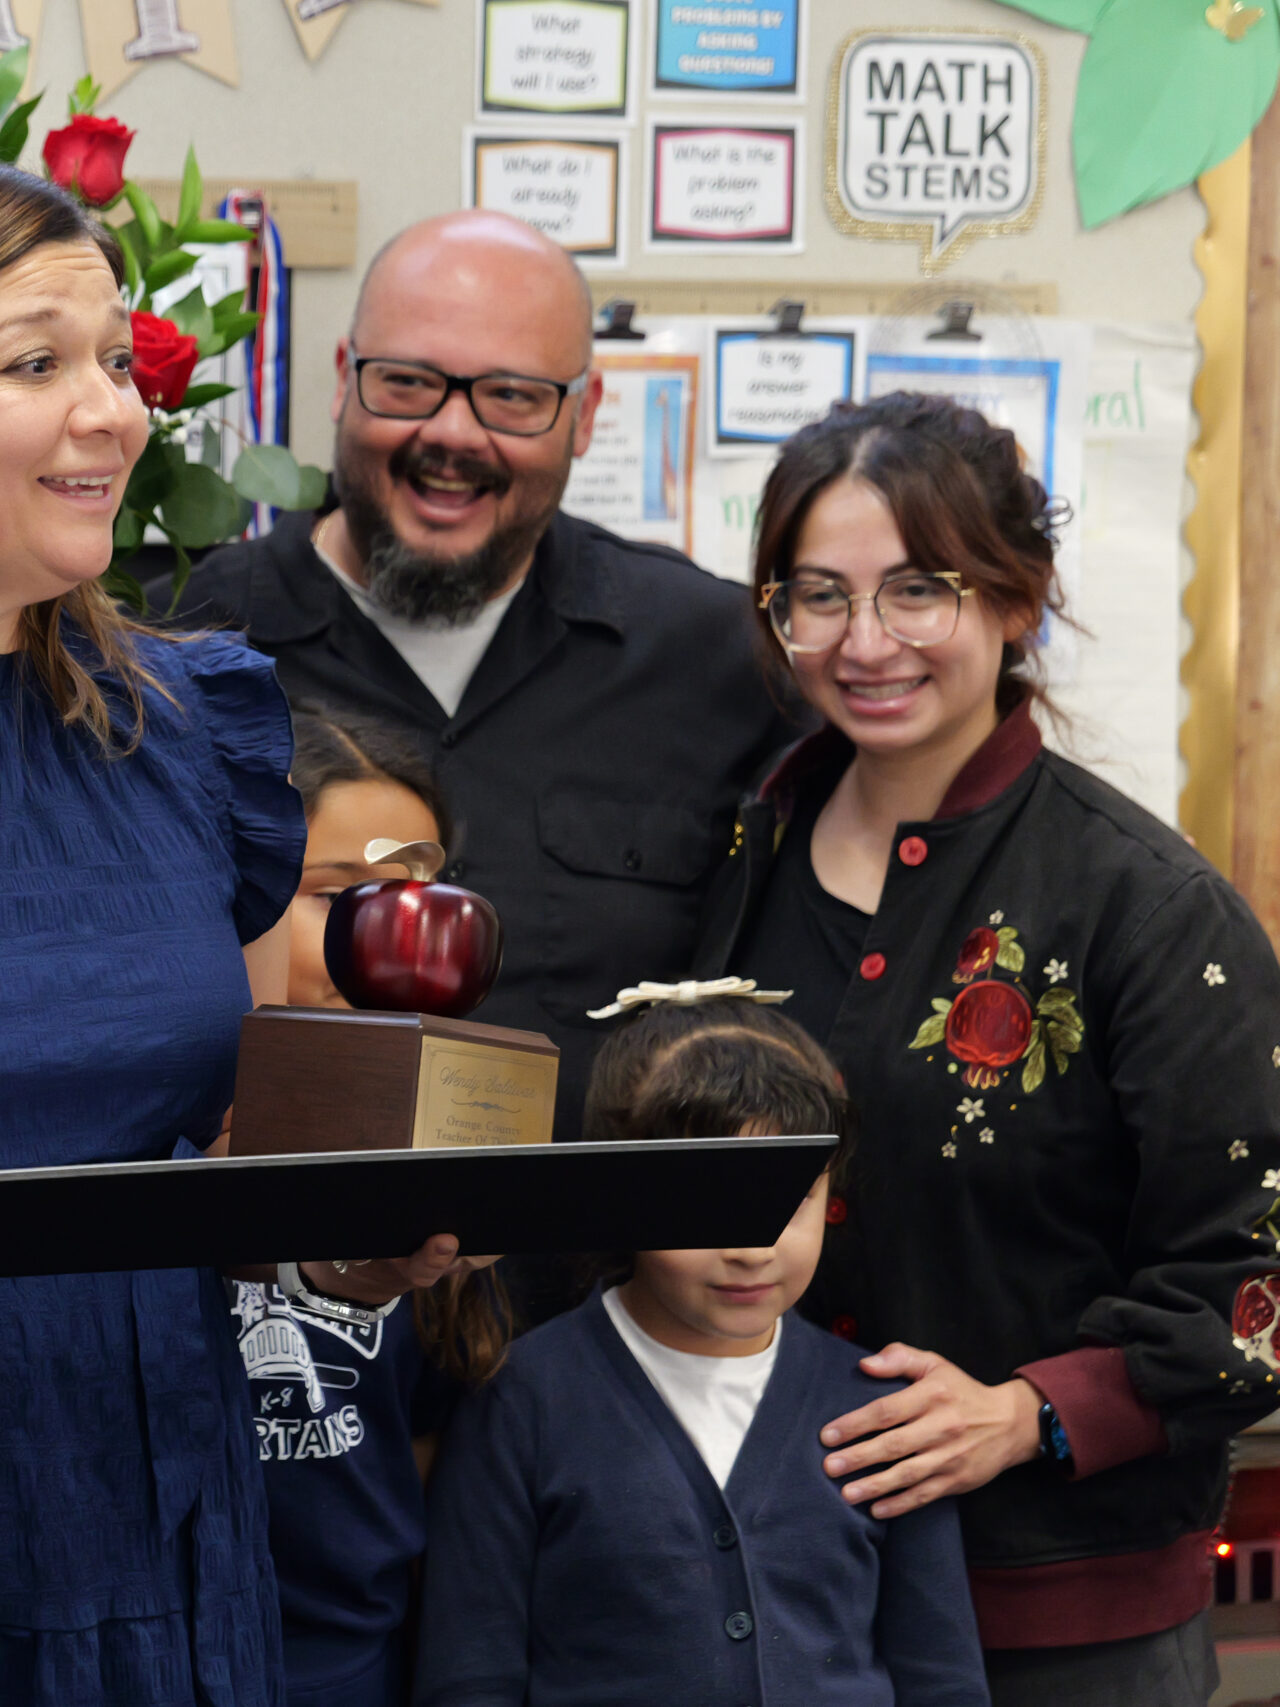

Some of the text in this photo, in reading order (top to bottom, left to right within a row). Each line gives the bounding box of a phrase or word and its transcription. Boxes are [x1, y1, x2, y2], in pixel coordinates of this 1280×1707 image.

[532, 14, 581, 35] What
[671, 7, 783, 30] PROBLEMS BY
[697, 31, 758, 51] ASKING
[514, 45, 595, 68] strategy
[511, 73, 598, 93] will I use?
[866, 60, 1013, 104] MATH
[866, 111, 1011, 158] TALK
[672, 143, 775, 163] What is the
[502, 155, 592, 175] What do I
[687, 175, 760, 193] problem
[865, 163, 1010, 201] STEMS
[510, 187, 581, 208] already
[690, 204, 754, 228] asking?
[777, 350, 804, 371] my
[747, 378, 811, 394] answer
[440, 1066, 480, 1096] Wendy
[446, 1115, 521, 1136] Orange County
[436, 1128, 471, 1143] Teacher
[475, 1134, 487, 1145] Of
[260, 1387, 295, 1414] K-8
